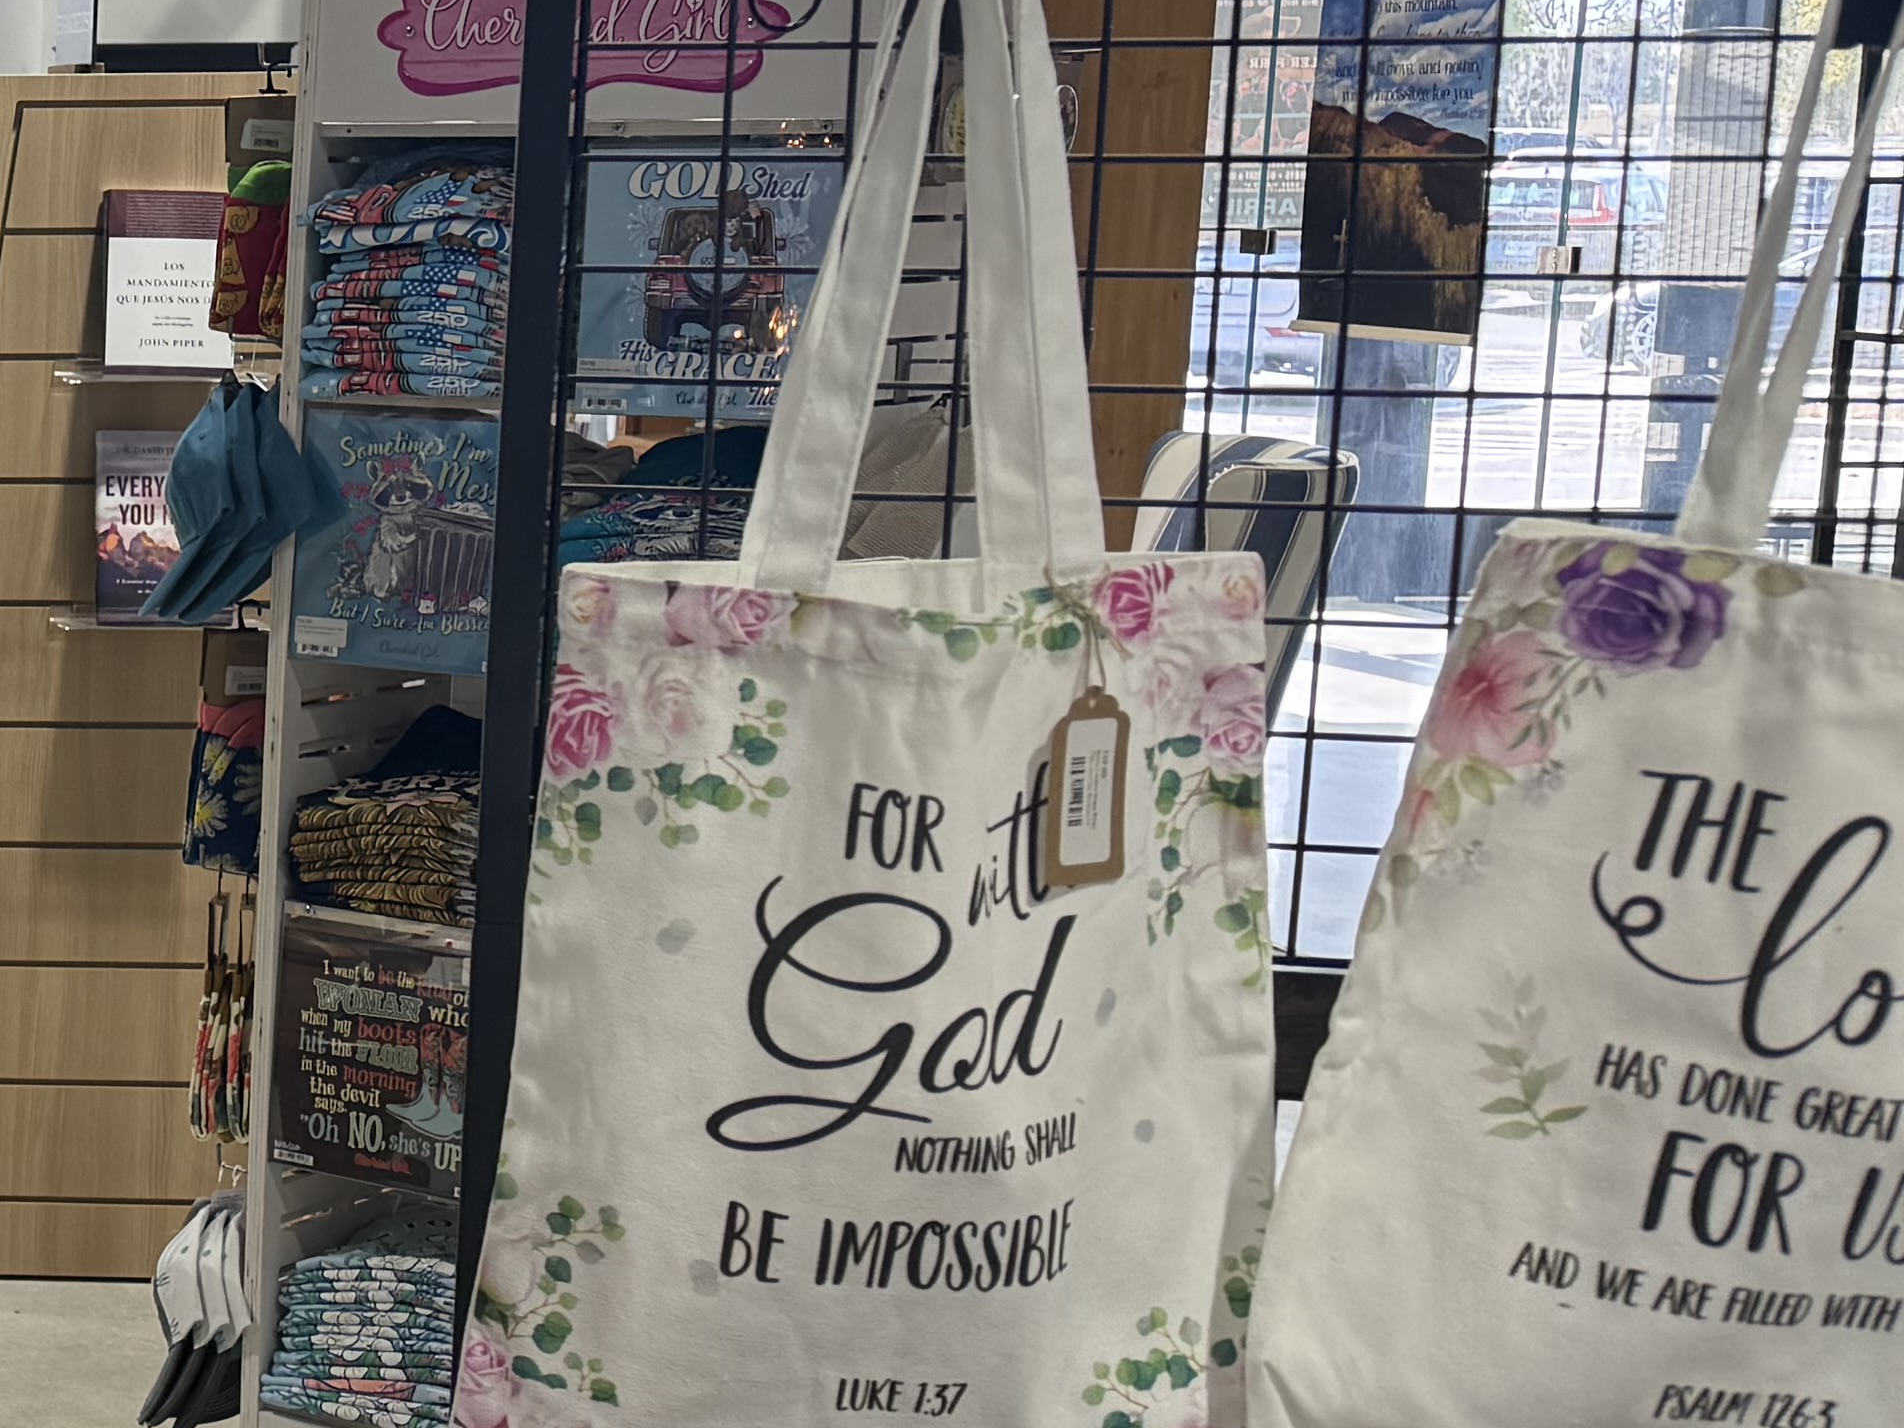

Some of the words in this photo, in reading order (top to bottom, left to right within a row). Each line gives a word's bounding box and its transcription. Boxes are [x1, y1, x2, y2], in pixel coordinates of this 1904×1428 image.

[628, 160, 746, 199] GOD
[744, 165, 815, 203] Shed
[164, 262, 185, 271] LOS
[116, 294, 140, 305] QUE
[177, 296, 200, 305] NOS
[138, 338, 170, 348] JOHN
[172, 339, 204, 348] PIPER
[619, 339, 658, 363] His
[342, 431, 449, 466] Sometimes
[452, 432, 490, 462] I'm
[119, 504, 155, 526] YOU
[372, 604, 408, 630] Sure
[845, 782, 945, 873] FOR
[1634, 769, 1791, 894] THE
[333, 966, 360, 984] want
[363, 966, 375, 981] to
[313, 977, 424, 1024] WOMAN
[705, 875, 1078, 1153] God
[301, 1007, 328, 1027] when
[333, 1018, 352, 1038] my
[358, 1016, 417, 1046] boots
[298, 1026, 327, 1055] hit
[331, 1036, 352, 1058] the
[354, 1038, 420, 1075] FLOOR
[300, 1055, 313, 1072] in
[315, 1058, 338, 1077] the
[342, 1063, 418, 1100] morning
[310, 1074, 336, 1096] the
[340, 1083, 381, 1109] devil
[1595, 1043, 1668, 1100] HAS
[1679, 1063, 1783, 1124] DONE
[388, 1132, 431, 1159] she's
[894, 1134, 1017, 1173] NOTHING
[1025, 1111, 1077, 1168] SHALL
[1640, 1129, 1806, 1256] FOR
[719, 1200, 790, 1284] BE
[813, 1198, 1076, 1292] IMPOSSIBLE
[1509, 1241, 1580, 1290] AND
[1596, 1260, 1646, 1308] WE
[1652, 1276, 1717, 1320] ARE
[1721, 1286, 1813, 1327] FILLED
[1820, 1291, 1903, 1332] WITH
[836, 1377, 906, 1415] LUKE
[913, 1382, 969, 1416] 1:37
[1653, 1384, 1751, 1425] PSALM
